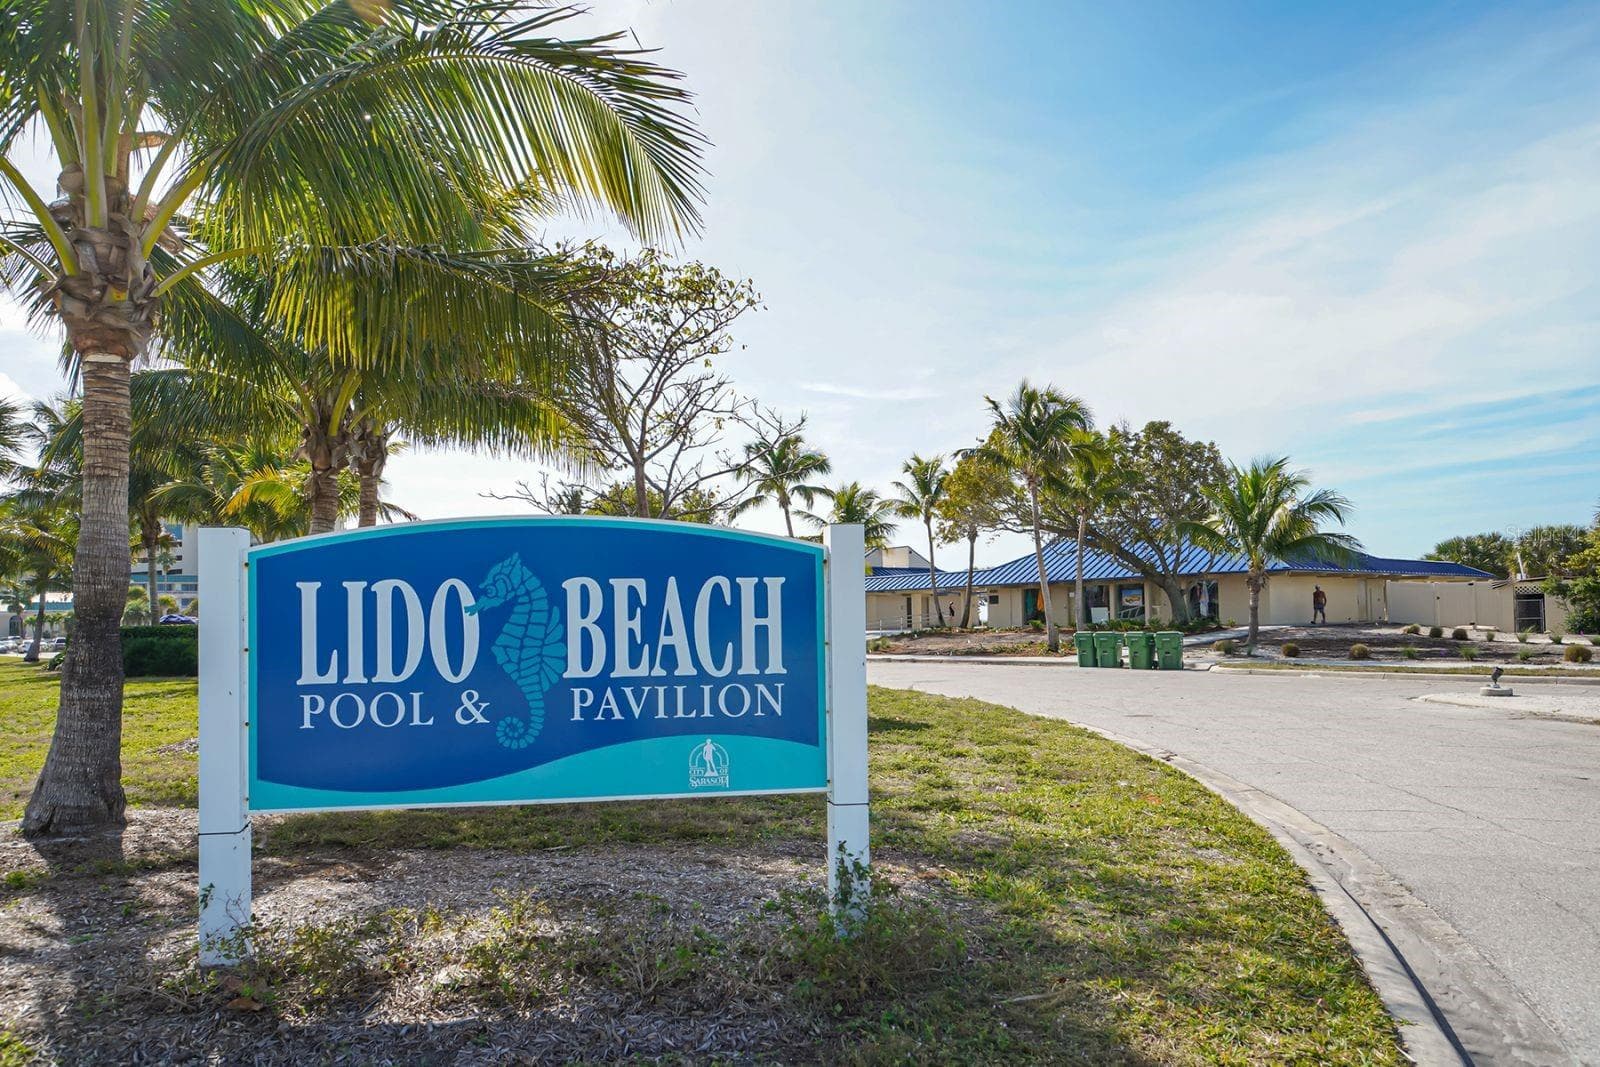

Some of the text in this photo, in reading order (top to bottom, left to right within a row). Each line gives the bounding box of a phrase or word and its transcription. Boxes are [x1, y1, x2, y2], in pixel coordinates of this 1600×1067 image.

[295, 575, 788, 686] LIDO BEACH
[299, 683, 785, 729] POOL & PAVILION
